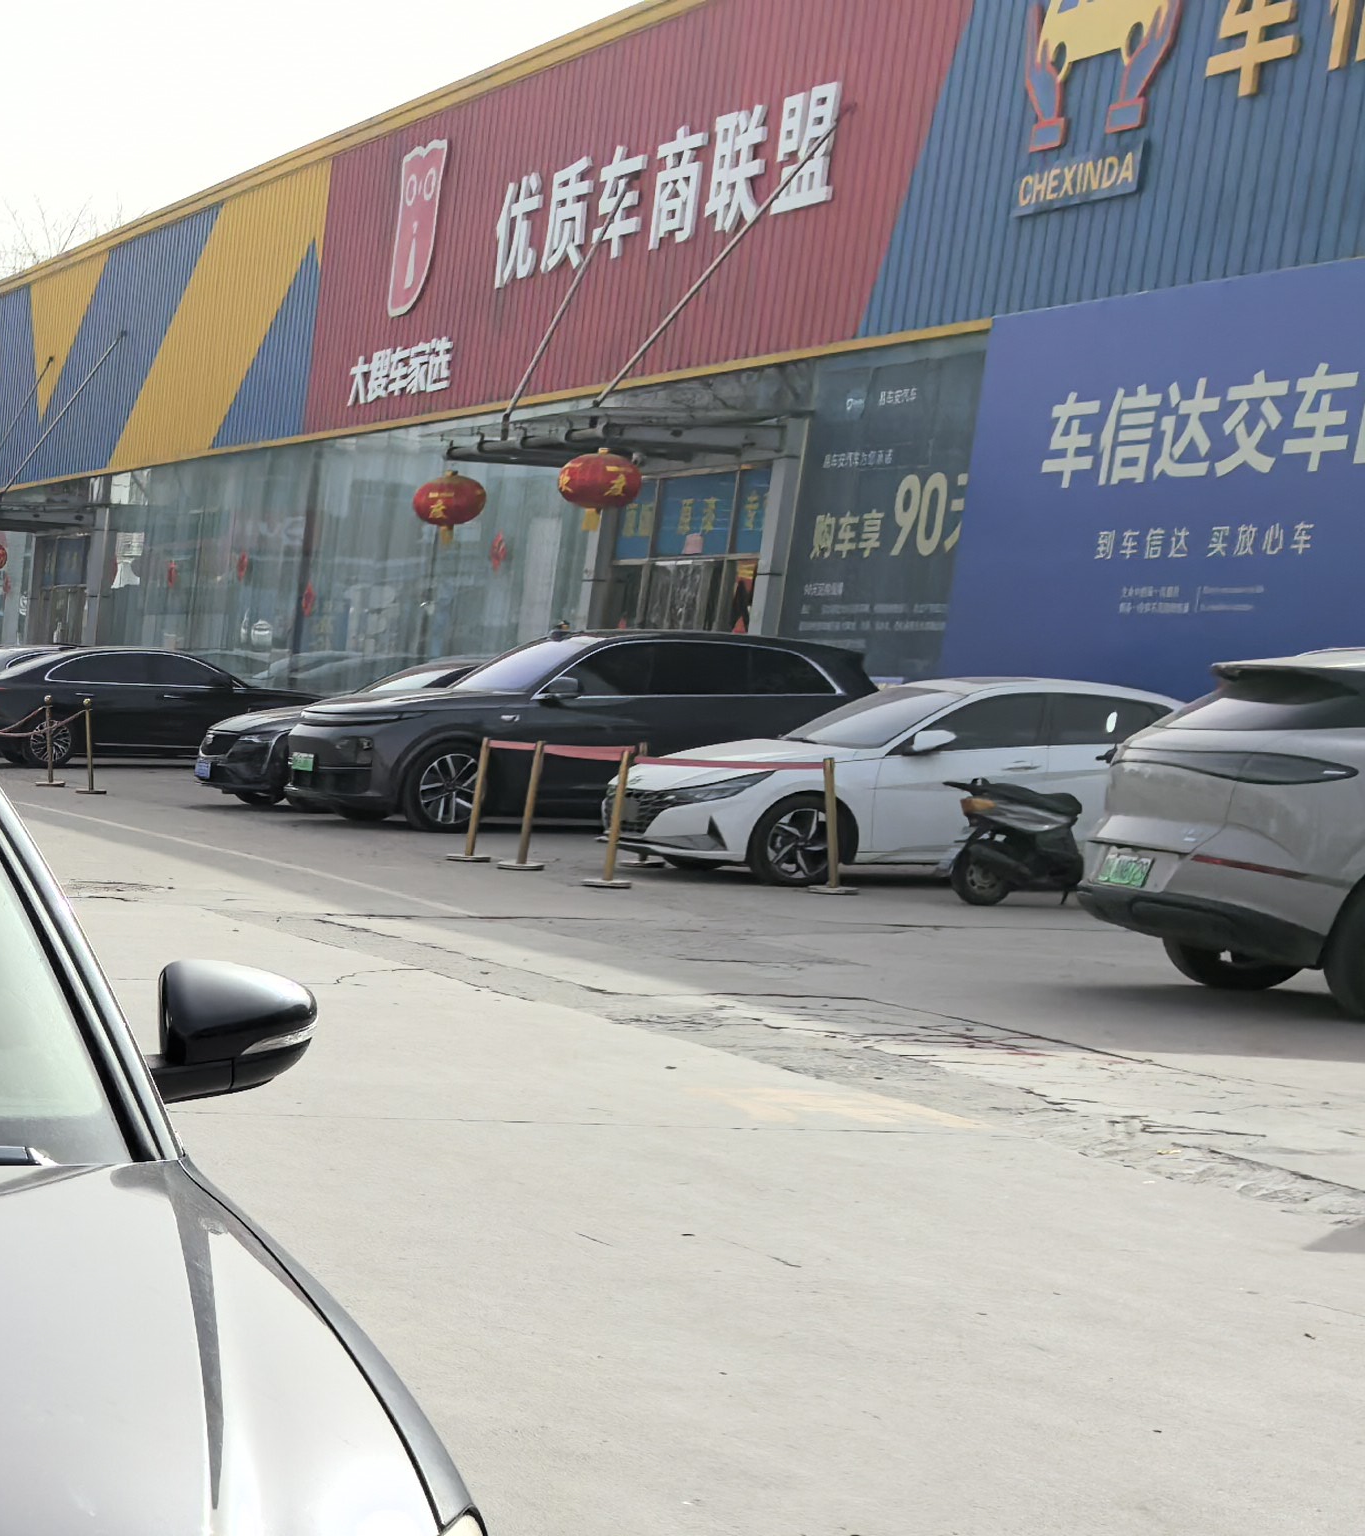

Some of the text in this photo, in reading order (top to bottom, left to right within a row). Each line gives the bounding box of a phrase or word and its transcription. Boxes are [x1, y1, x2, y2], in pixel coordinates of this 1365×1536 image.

[494, 81, 843, 289] 优质车商联盟
[1019, 152, 1135, 207] CHEXINDA
[347, 336, 453, 406] 大搜车家选
[1040, 362, 1365, 490] 车信达交车
[810, 510, 885, 560] 购车享
[1094, 520, 1315, 560] 到车信达 买放心车
